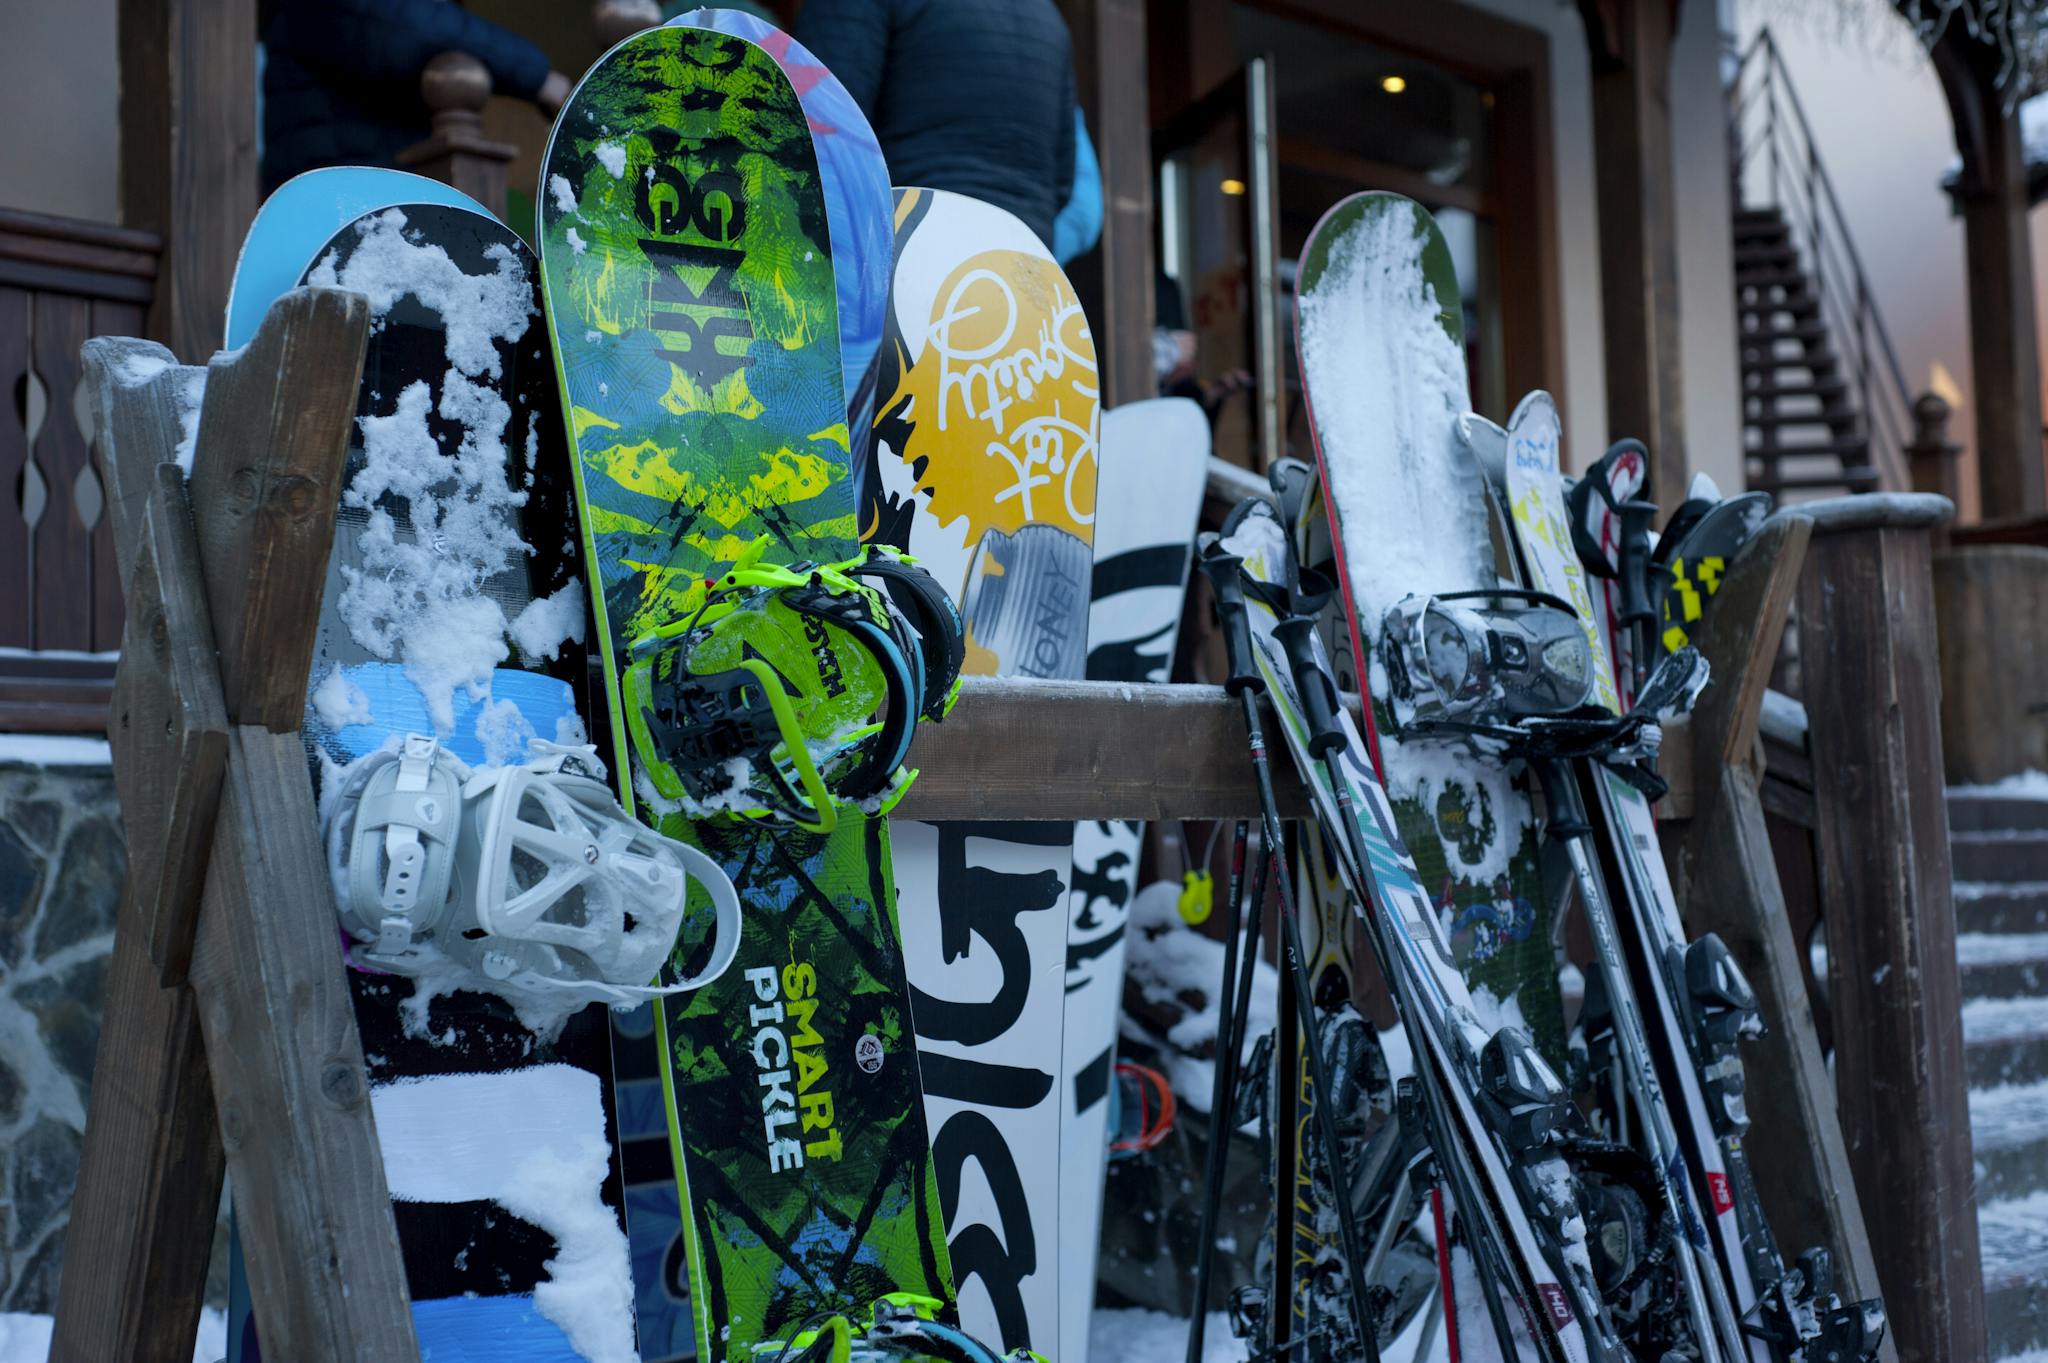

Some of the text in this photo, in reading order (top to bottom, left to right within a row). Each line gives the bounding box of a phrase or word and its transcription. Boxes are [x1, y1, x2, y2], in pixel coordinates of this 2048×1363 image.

[1019, 555, 1081, 679] ONEY
[744, 965, 804, 1174] PICKLE
[782, 962, 843, 1162] SMART
